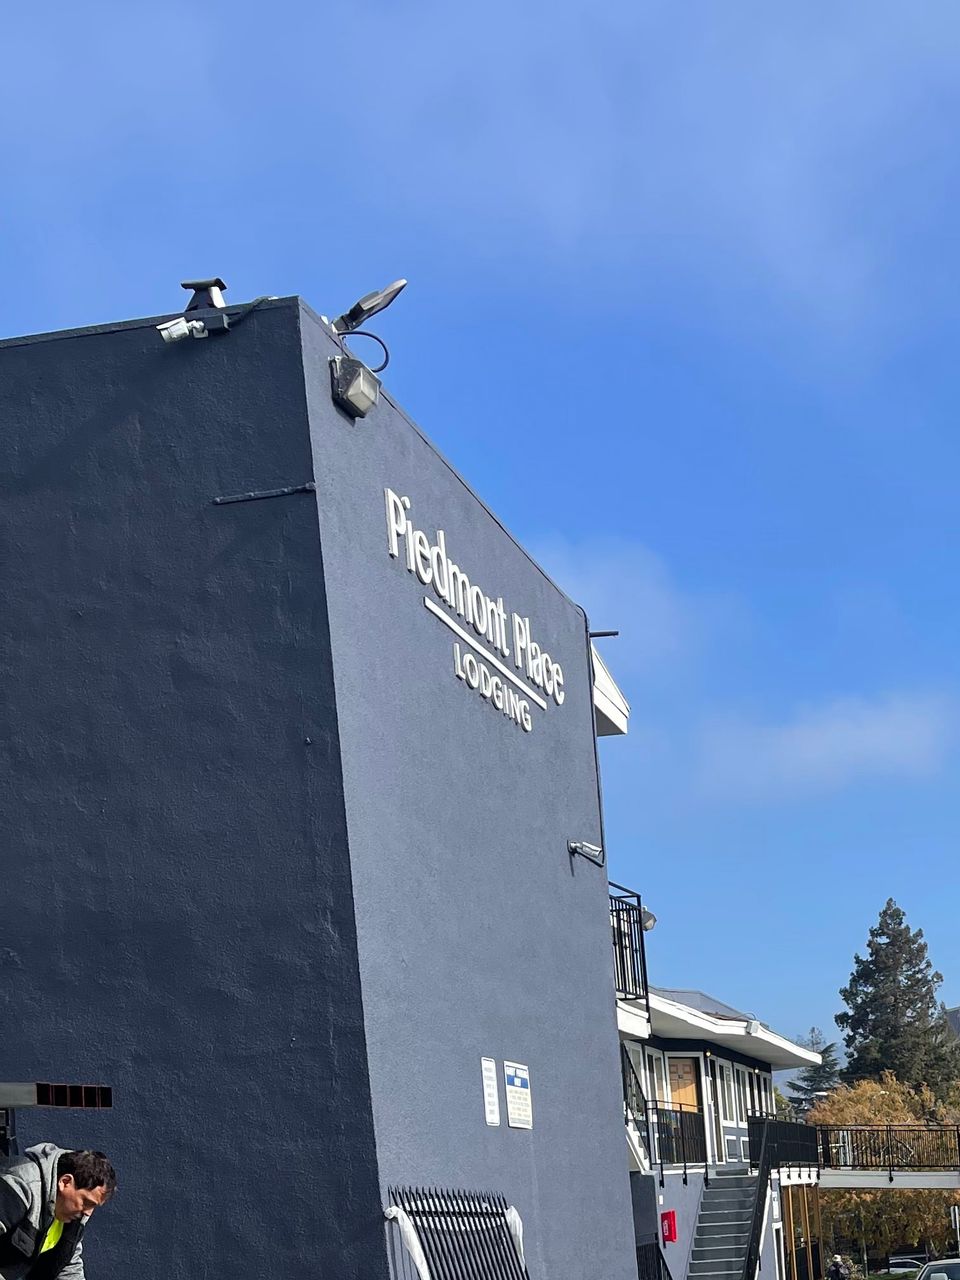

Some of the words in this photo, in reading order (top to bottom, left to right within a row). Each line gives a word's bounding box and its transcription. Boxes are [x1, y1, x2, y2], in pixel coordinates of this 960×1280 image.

[384, 488, 511, 657] Piedmont
[511, 612, 565, 706] Place
[453, 642, 533, 732] LODGING
